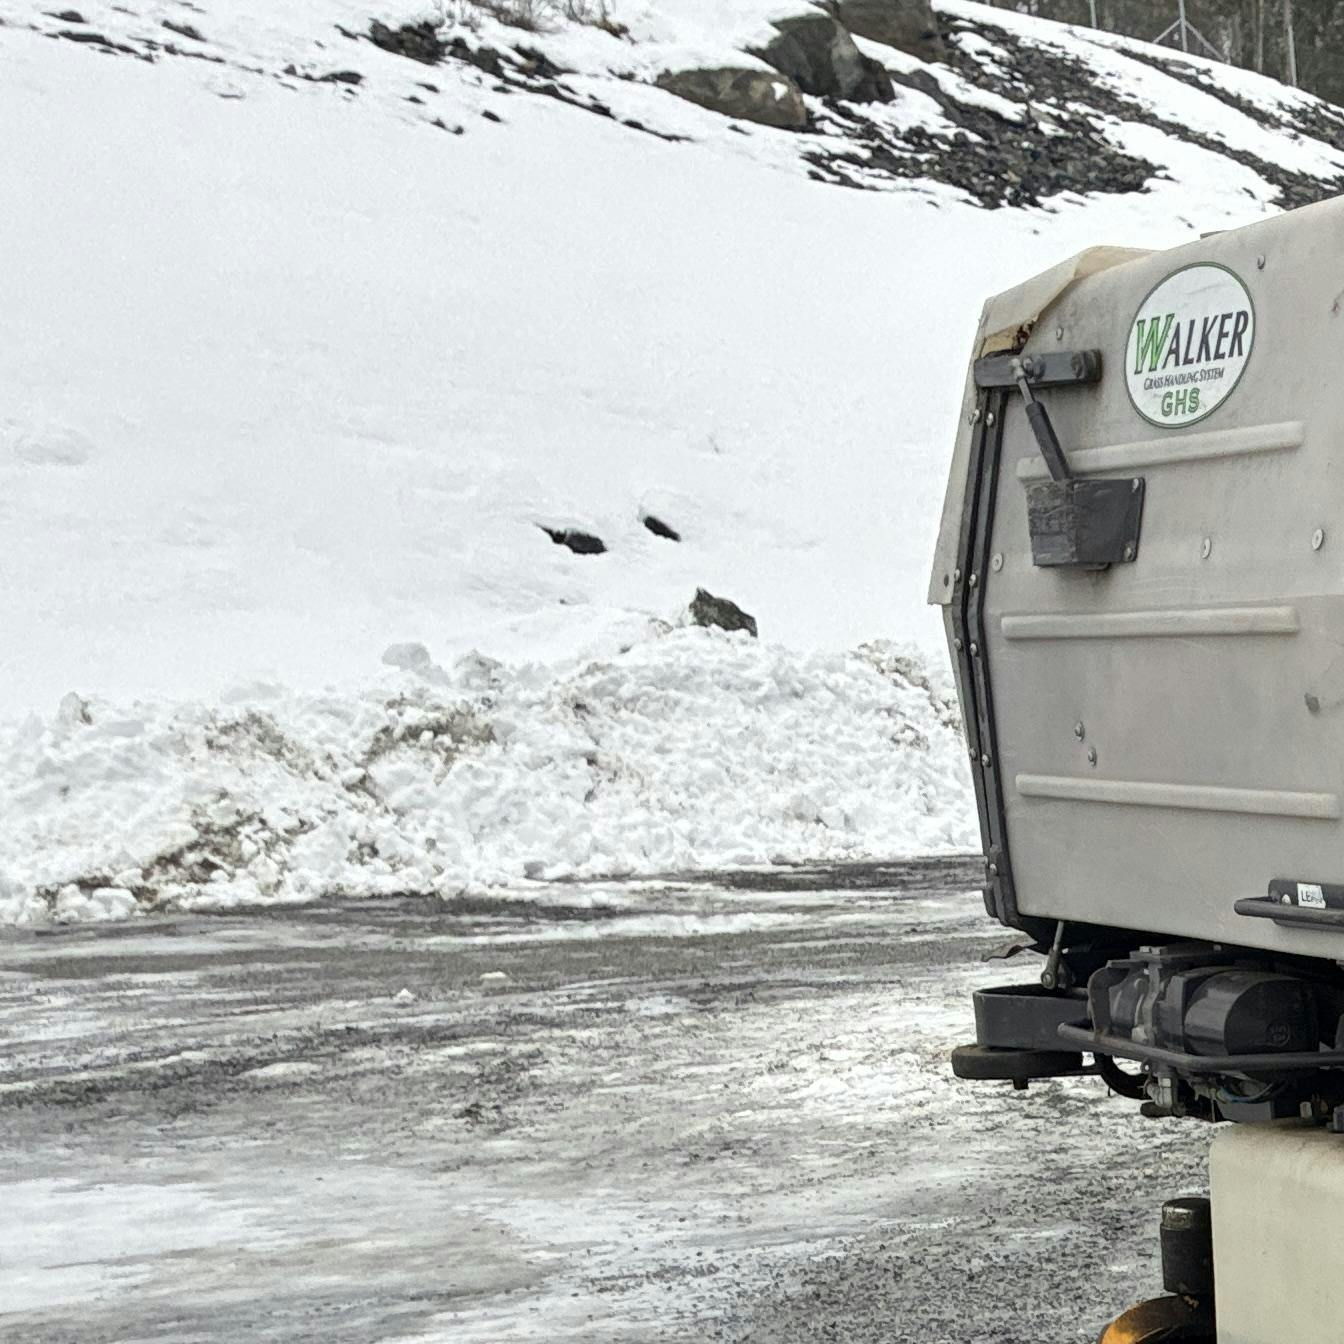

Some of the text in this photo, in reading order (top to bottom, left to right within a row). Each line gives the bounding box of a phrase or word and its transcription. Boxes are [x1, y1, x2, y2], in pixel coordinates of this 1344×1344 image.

[1134, 310, 1249, 375] WALKER
[1199, 366, 1225, 382] SYSTEM
[1161, 387, 1201, 417] GHS
